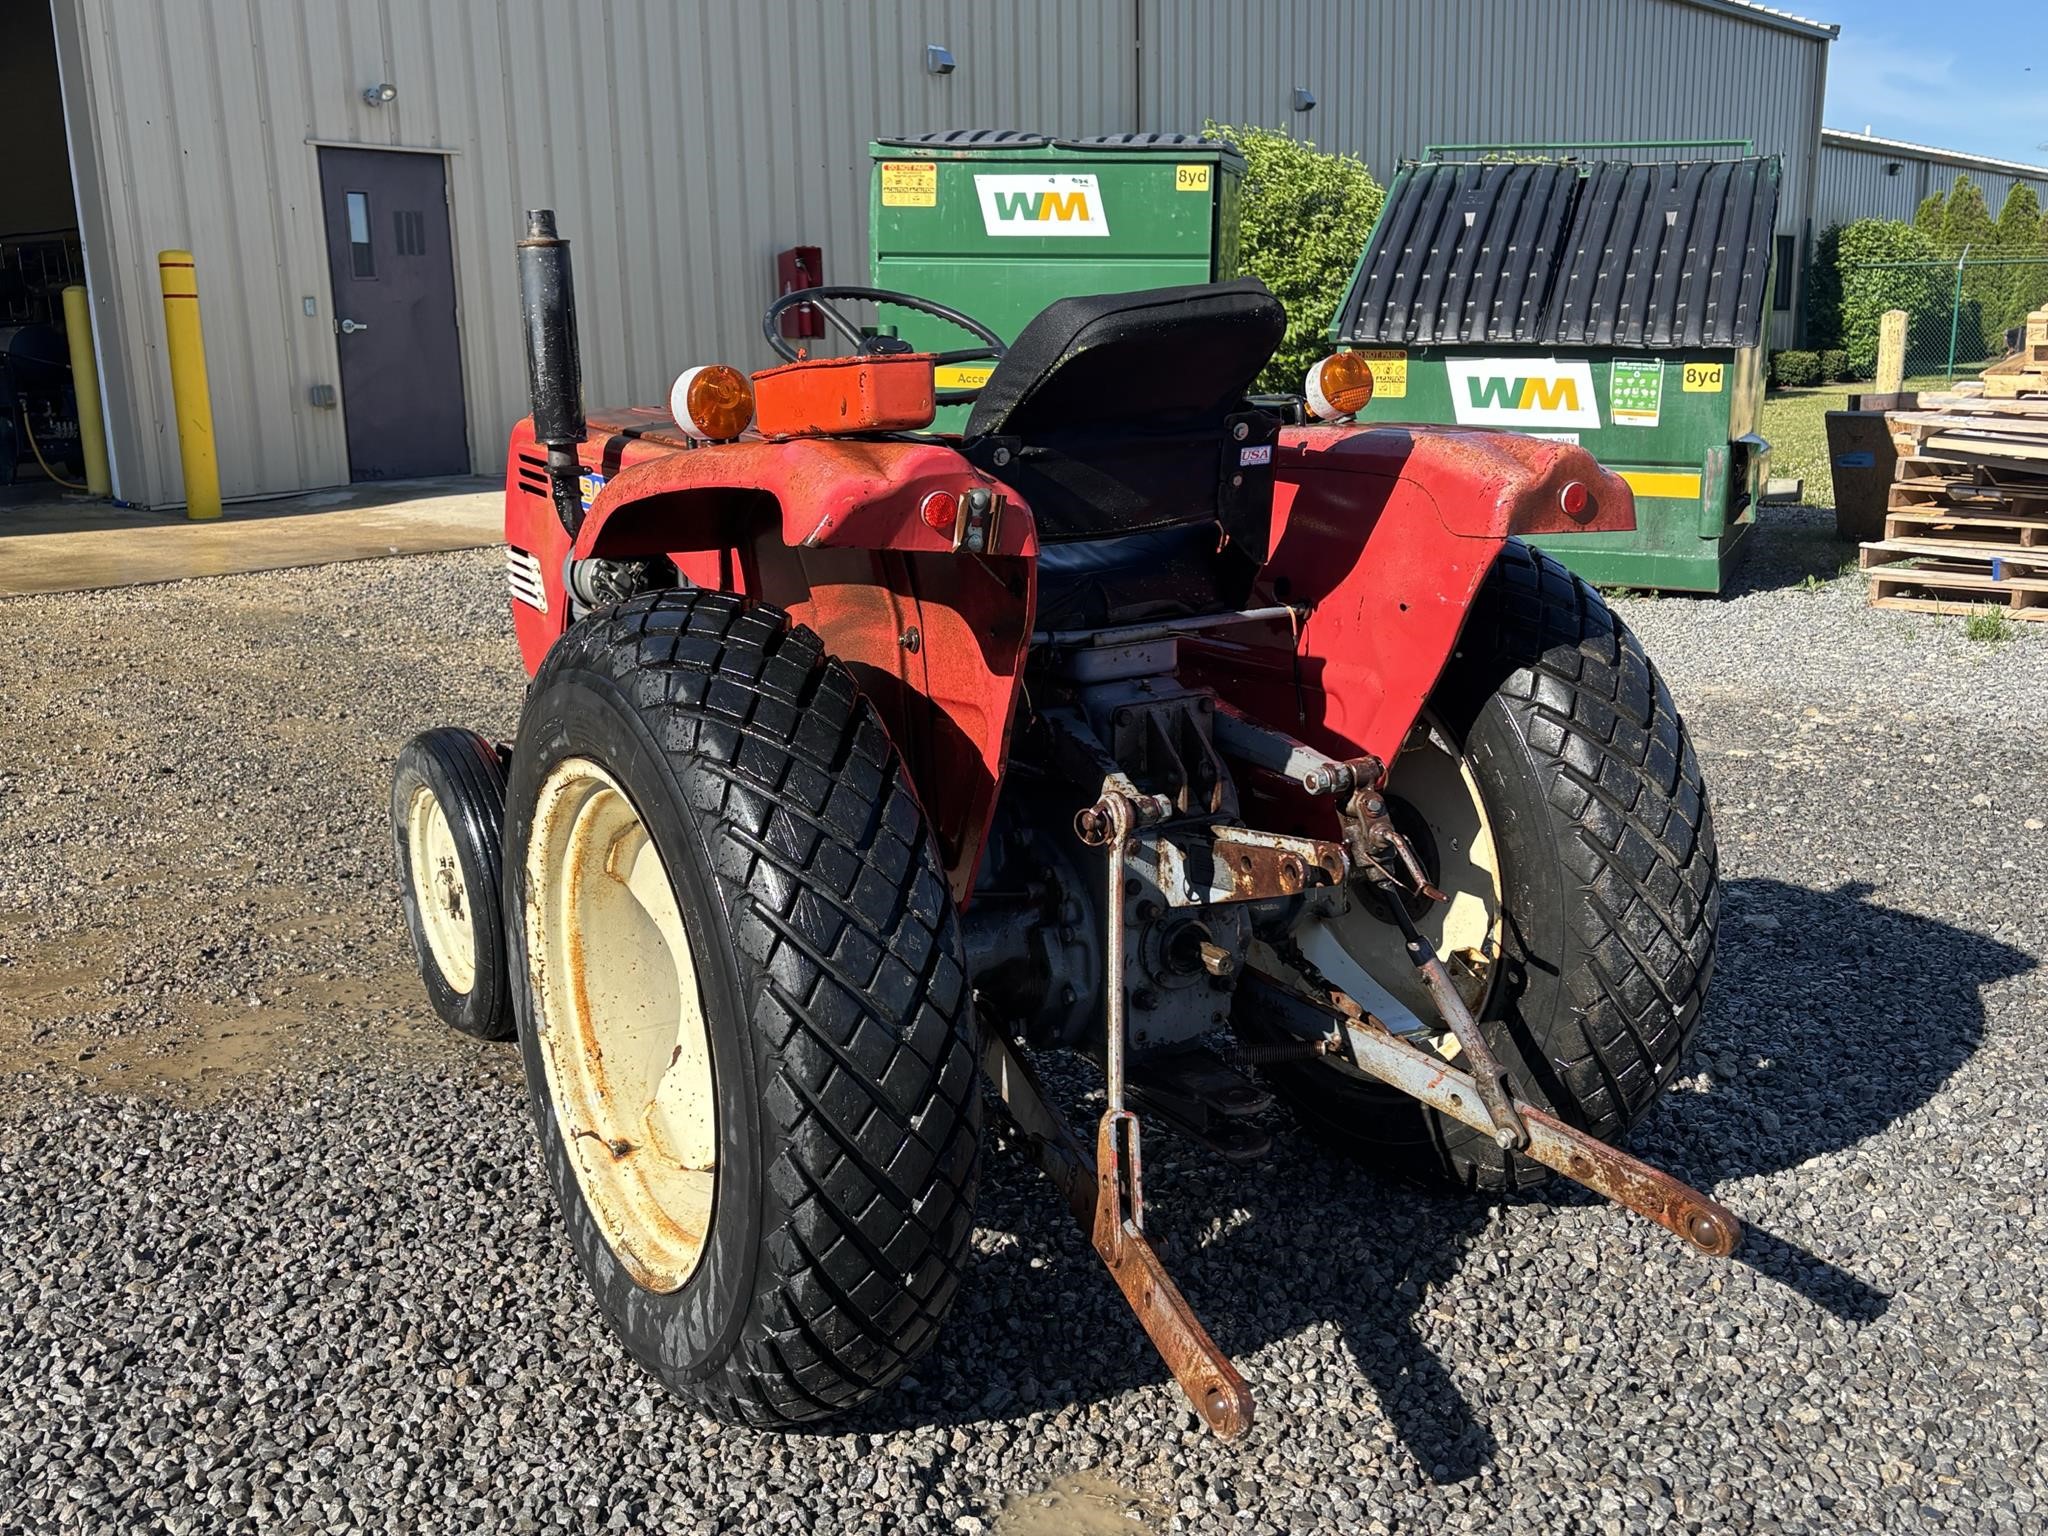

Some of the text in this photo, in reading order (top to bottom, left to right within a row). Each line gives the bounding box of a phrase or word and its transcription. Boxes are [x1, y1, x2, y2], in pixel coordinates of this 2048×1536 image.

[1178, 169, 1207, 187] 8yd
[993, 191, 1090, 221] WM
[1365, 351, 1379, 359] NOT
[1381, 351, 1401, 359] PARK
[957, 373, 988, 384] Acce
[1685, 368, 1721, 386] 8yd
[1466, 376, 1580, 411] WM
[1242, 449, 1268, 461] USA
